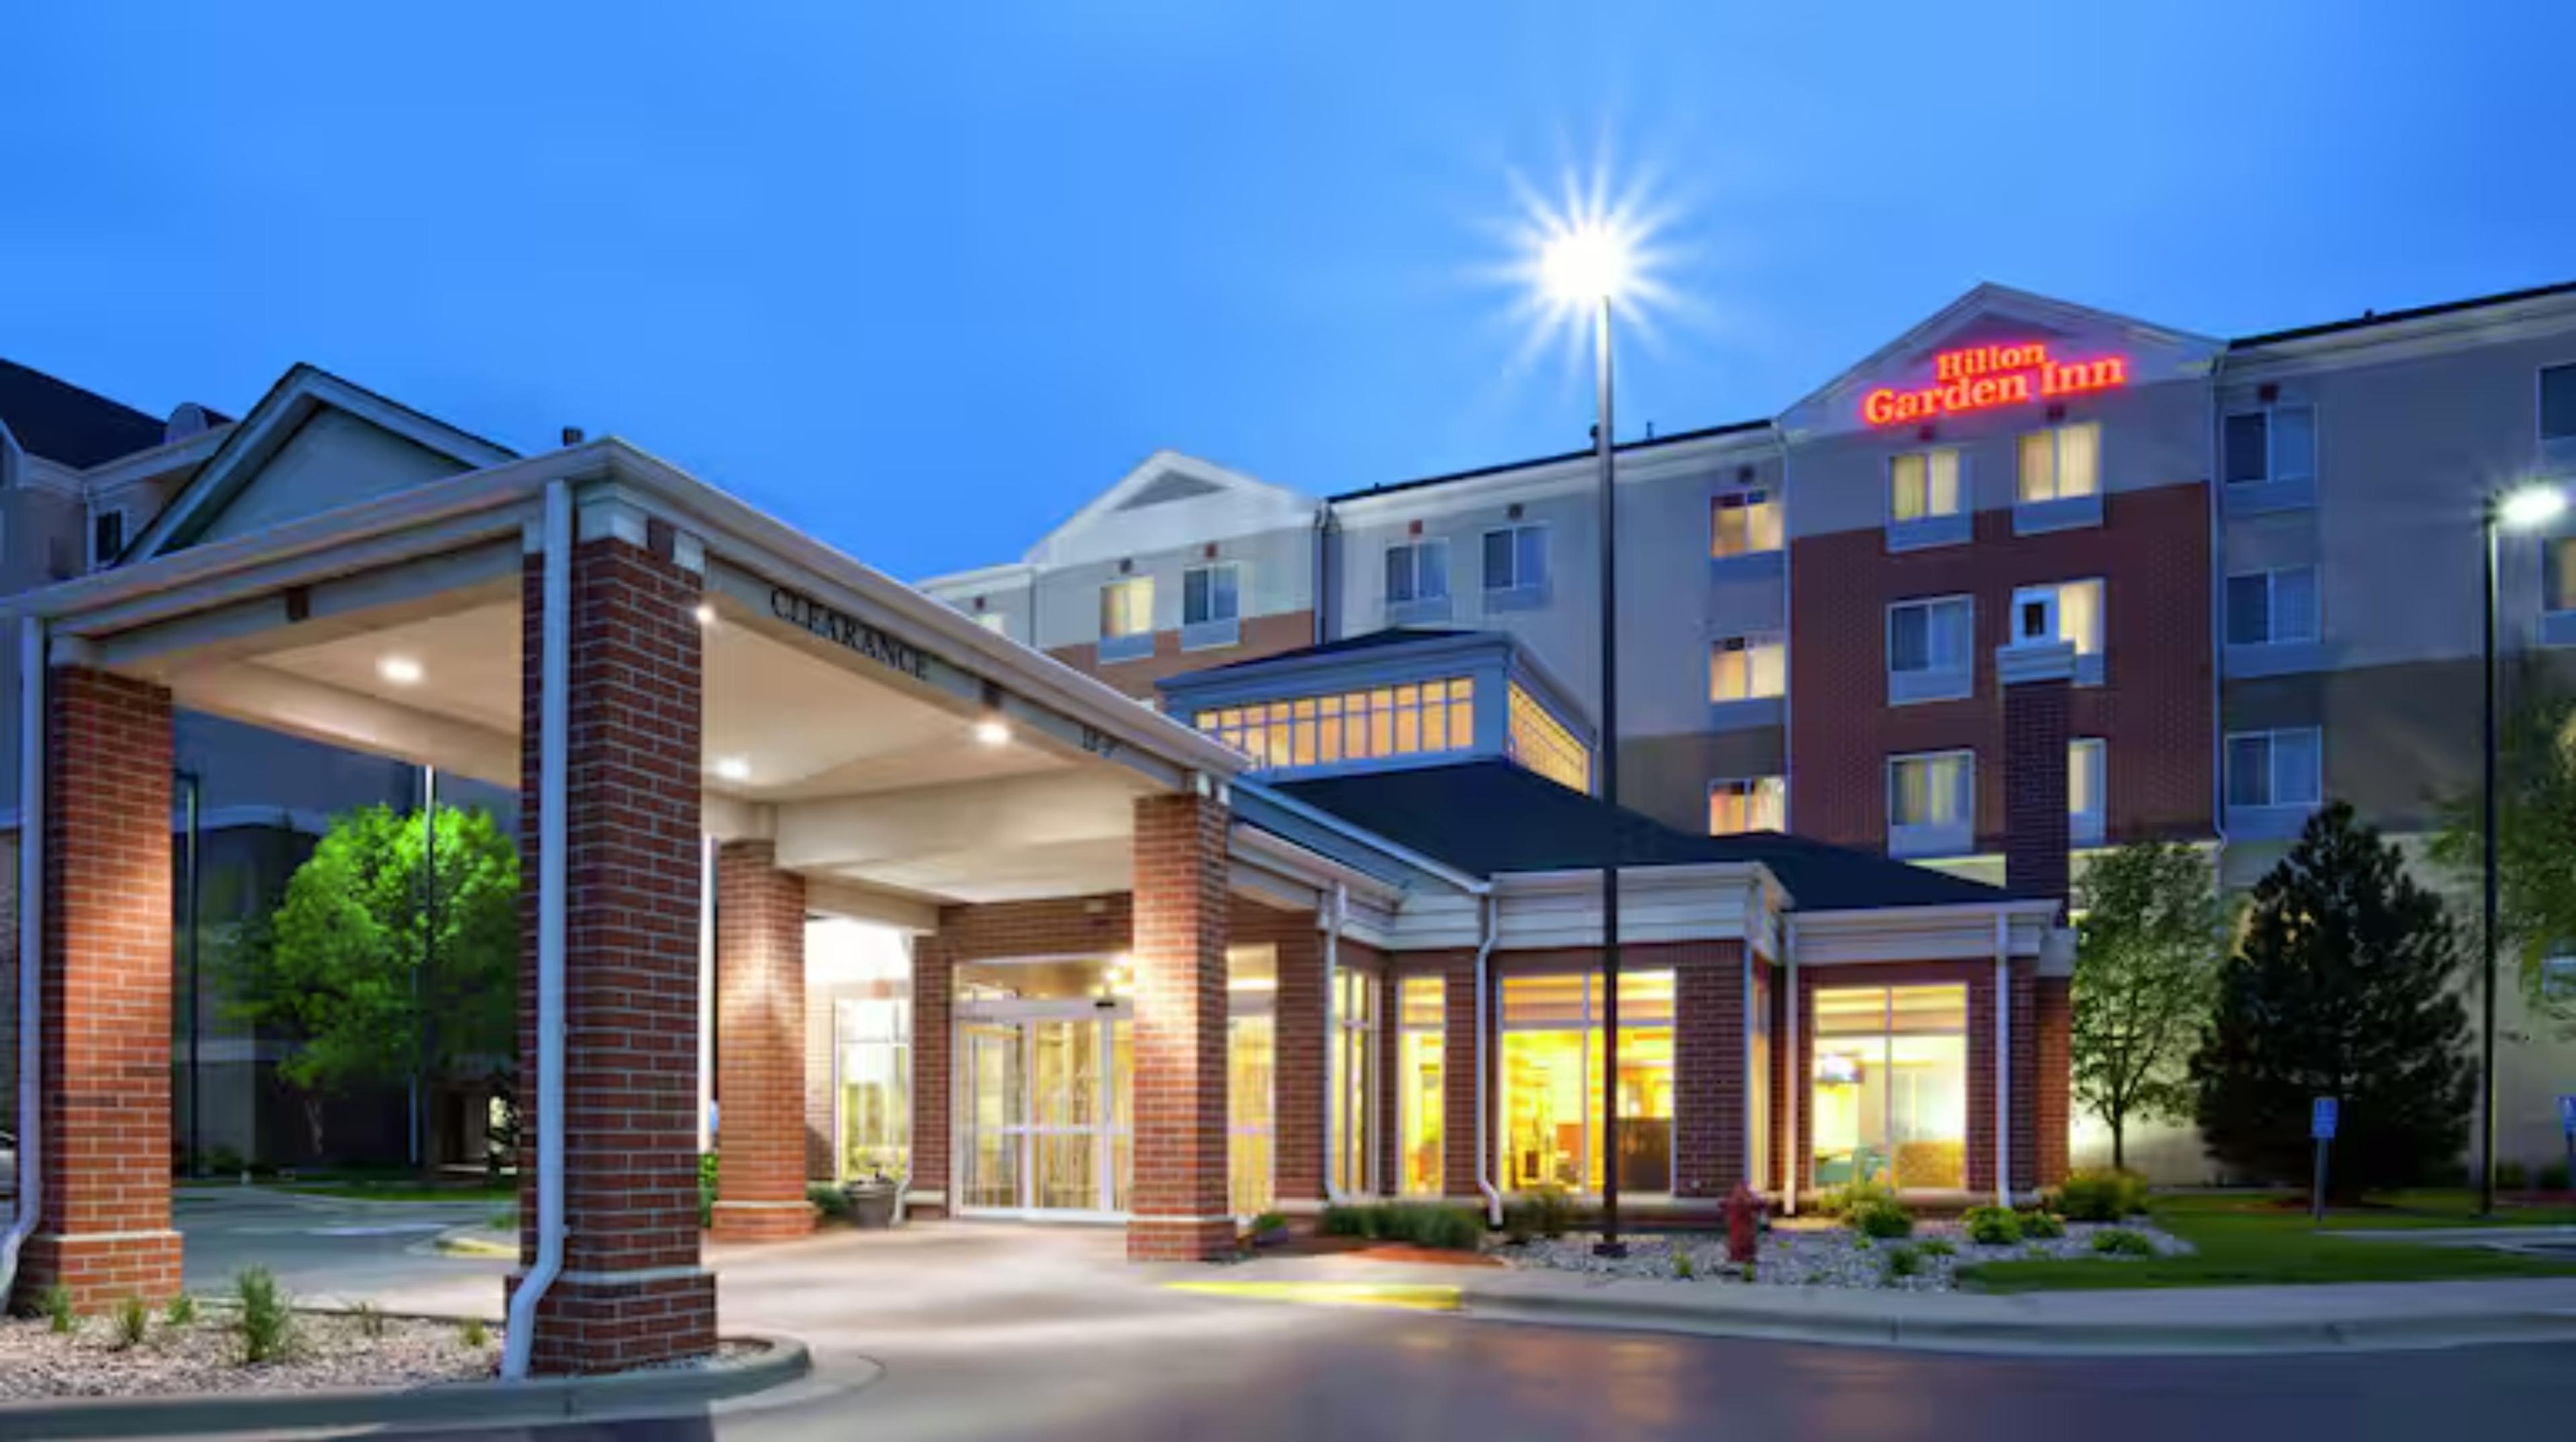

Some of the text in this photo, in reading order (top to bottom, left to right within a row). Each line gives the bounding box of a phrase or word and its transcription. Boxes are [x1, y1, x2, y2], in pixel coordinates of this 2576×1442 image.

[1864, 356, 2126, 423] Garden Inn
[1936, 342, 2046, 380] Hilton
[771, 588, 928, 682] CLEARANCE
